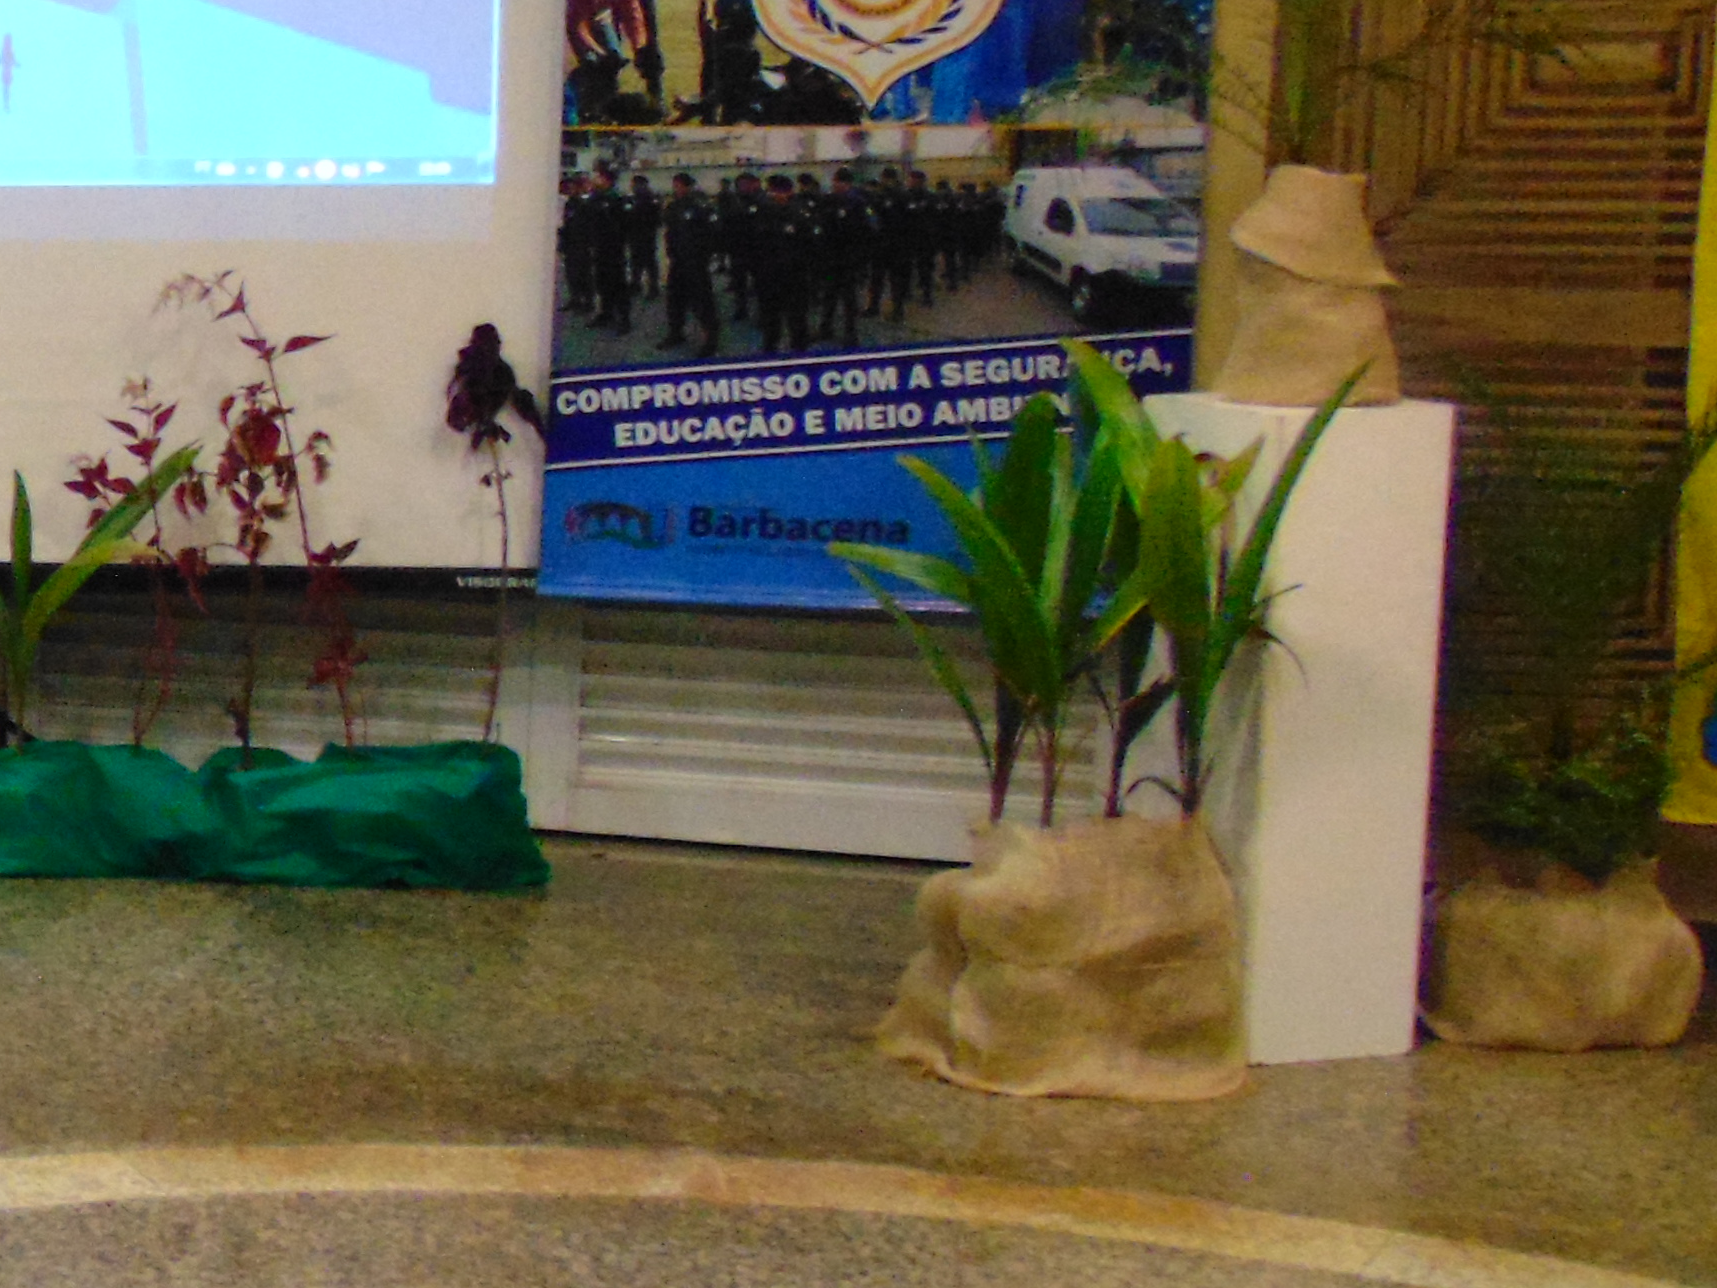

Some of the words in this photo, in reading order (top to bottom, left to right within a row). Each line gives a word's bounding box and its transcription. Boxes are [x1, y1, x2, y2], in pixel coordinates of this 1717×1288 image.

[556, 372, 811, 416] COMPROMISSO
[818, 367, 898, 396] COM
[907, 364, 932, 391] A
[940, 346, 1174, 391] SEGURÇA,
[614, 408, 794, 448] EDUCAÇÃO
[804, 409, 825, 435] E
[835, 404, 923, 432] MEIO
[688, 505, 911, 544] Barbacena
